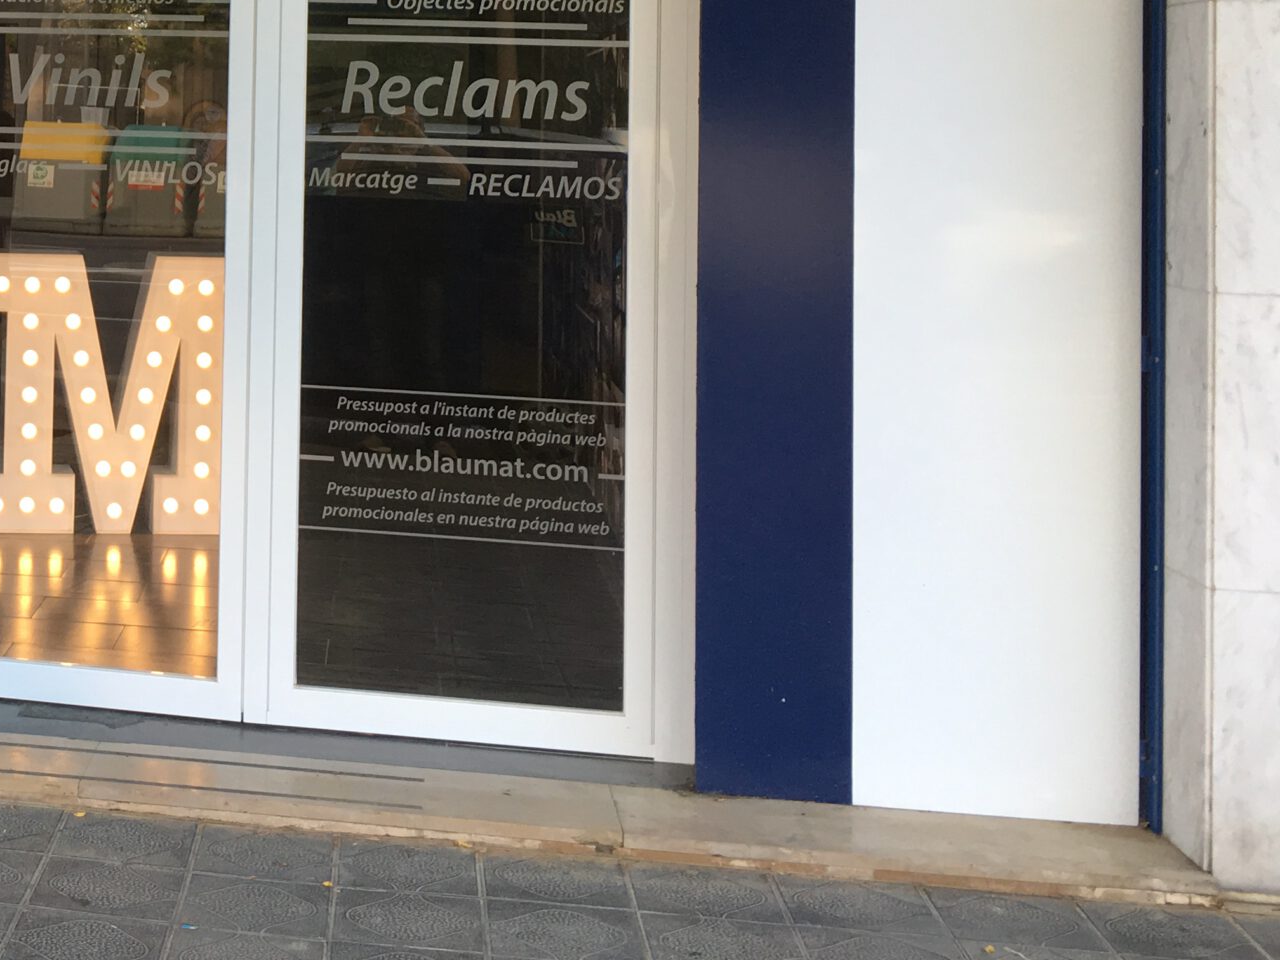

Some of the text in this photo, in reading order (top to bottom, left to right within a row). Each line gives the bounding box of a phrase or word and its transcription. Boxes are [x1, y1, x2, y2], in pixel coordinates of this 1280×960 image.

[9, 52, 173, 108] Vinils
[341, 60, 590, 122] Reclams
[115, 159, 218, 185] VINILOS
[308, 167, 621, 200] Marcatge RECLAMOS
[336, 396, 596, 425] Pressupost a l'instant de productes
[328, 418, 607, 447] promocionals a la nostra pàgina web
[341, 449, 589, 482] www.blaumat.com
[326, 481, 604, 514] Presupuesto al instante de productos
[322, 504, 610, 537] promocionales en nuestra página web
